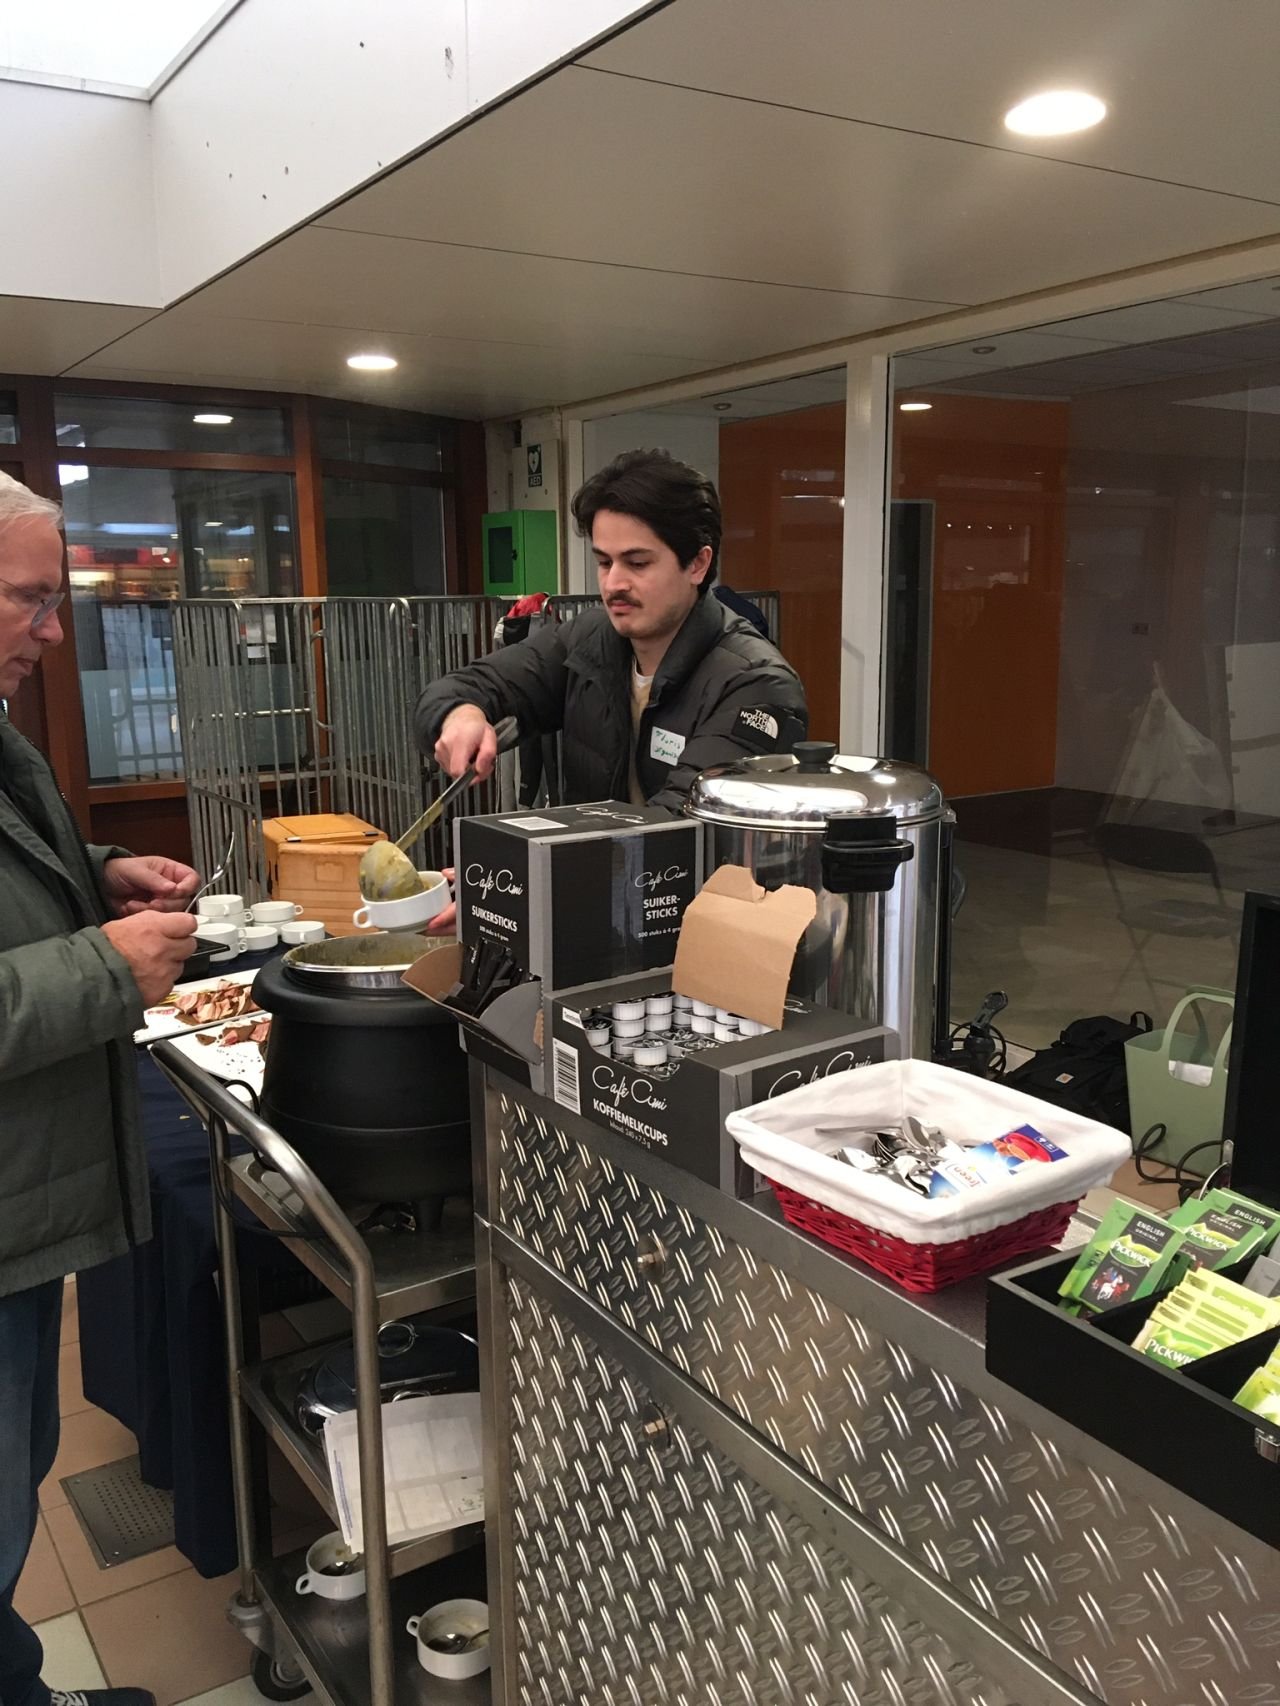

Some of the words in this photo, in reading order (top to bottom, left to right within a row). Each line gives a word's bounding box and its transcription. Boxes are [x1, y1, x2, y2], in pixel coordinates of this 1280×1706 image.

[740, 711, 768, 726] NORTH
[755, 709, 770, 719] THE
[746, 718, 766, 732] FACE
[643, 894, 681, 909] SUIKER-
[471, 904, 518, 932] SUIKERSTICKS
[645, 906, 678, 921] STICKS
[593, 1098, 668, 1147] KOFFIEMELKCUPS
[1210, 1213, 1243, 1230] ENGLISH
[1234, 1208, 1266, 1226] ENGLISH
[1136, 1220, 1166, 1238] ENGLISH
[1186, 1227, 1228, 1251] PICKWICK
[1110, 1240, 1151, 1268] PICKWICK
